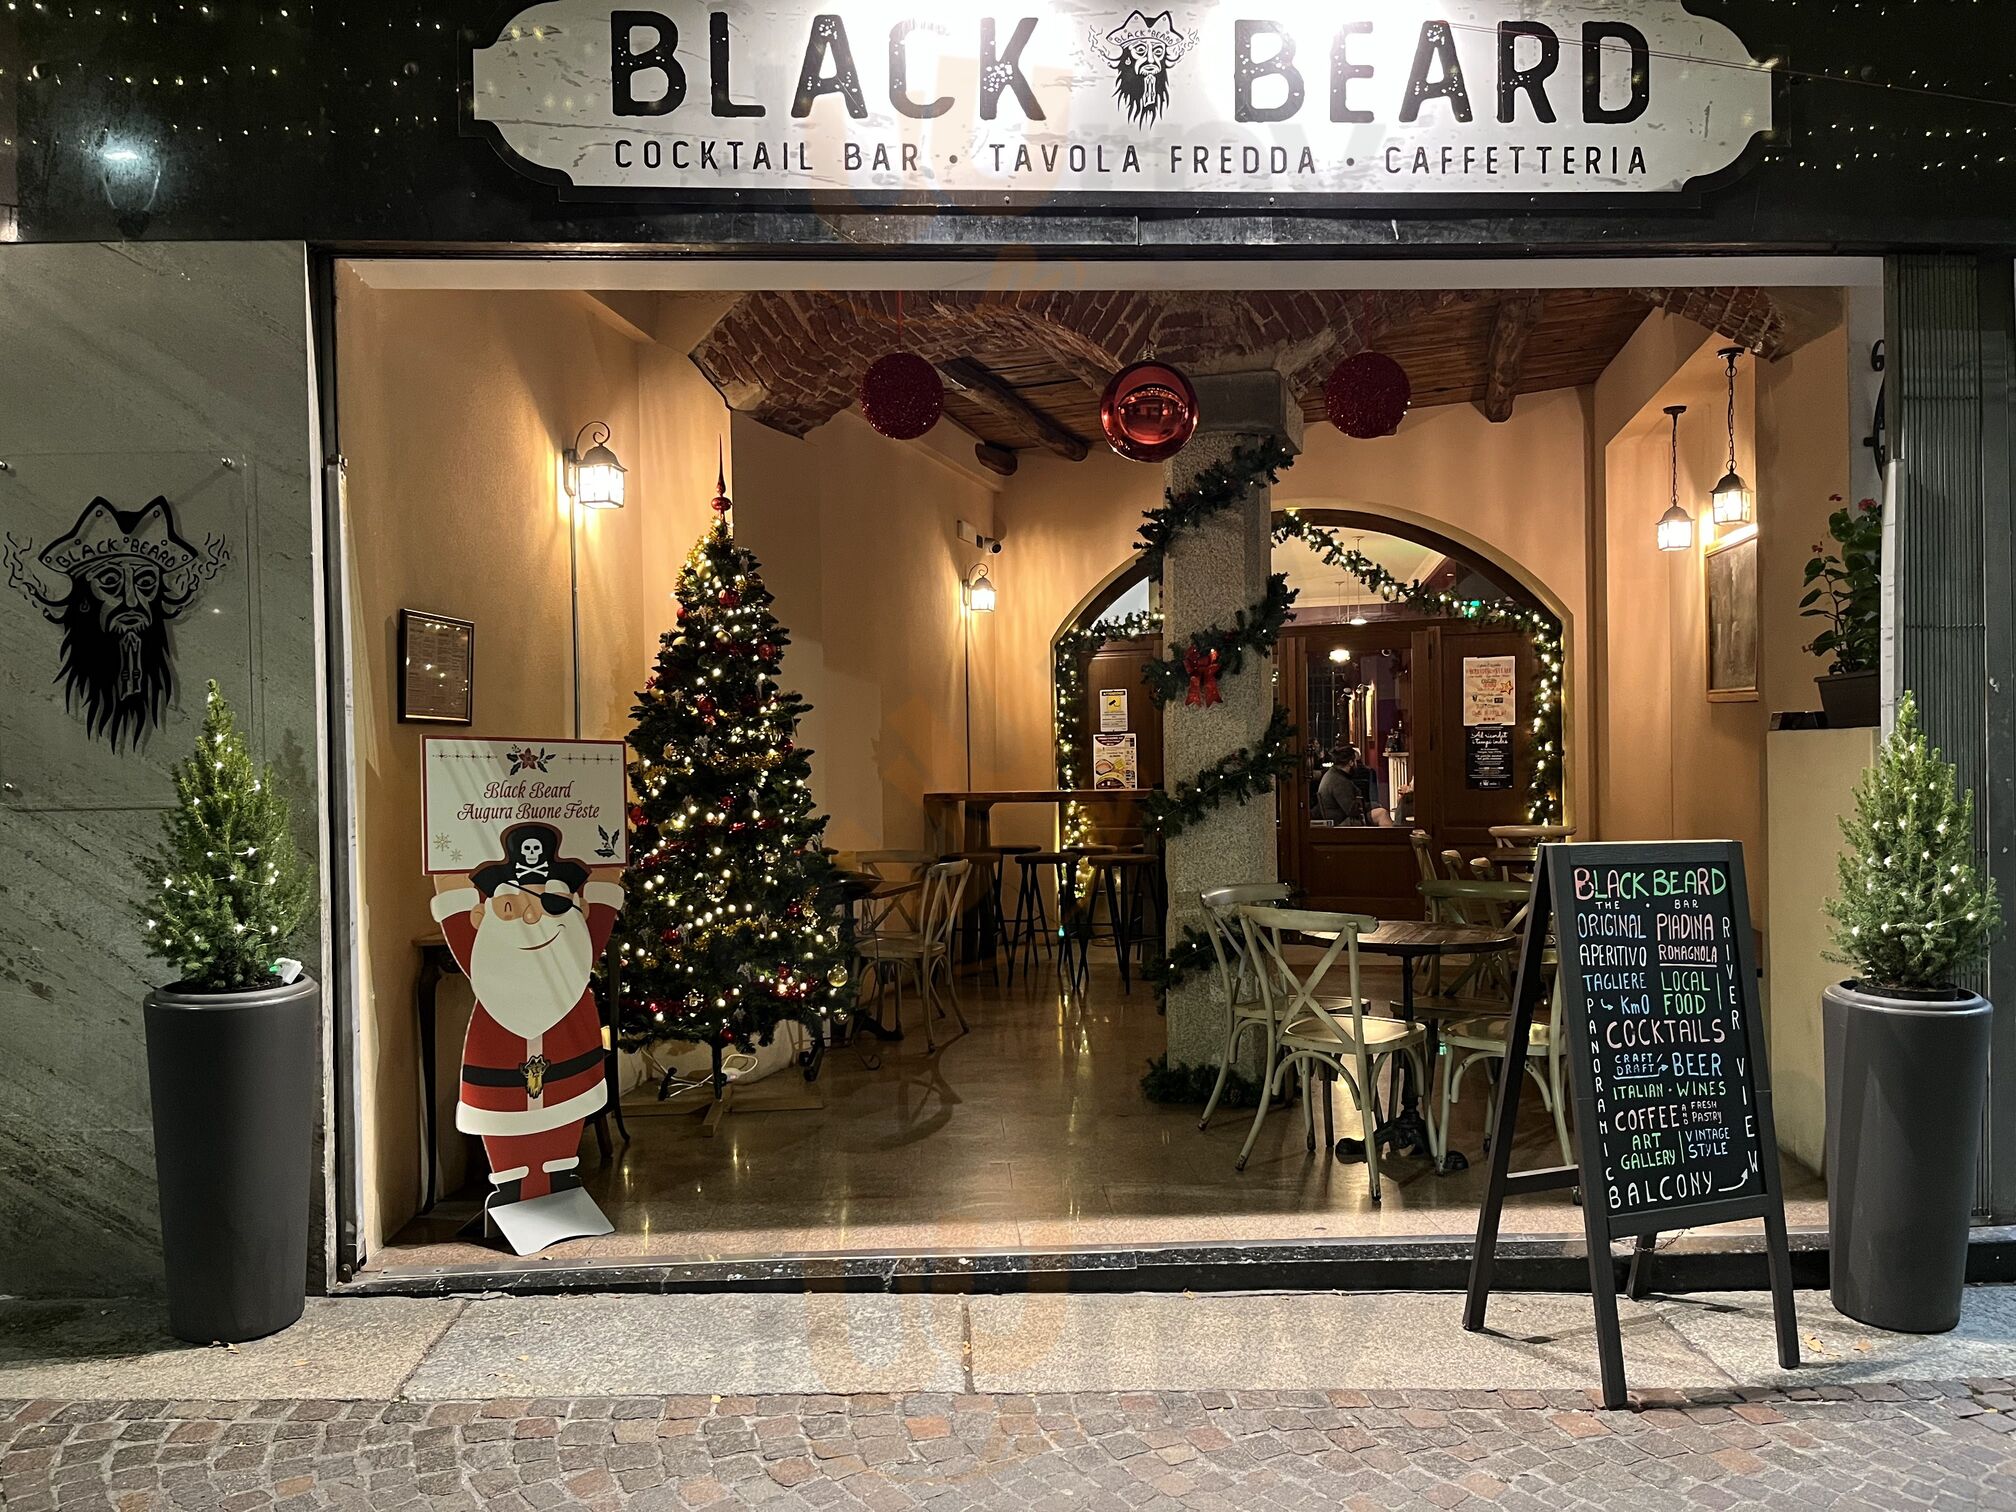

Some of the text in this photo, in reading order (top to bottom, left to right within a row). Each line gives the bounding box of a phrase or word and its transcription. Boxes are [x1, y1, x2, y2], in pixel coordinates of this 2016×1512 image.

[1114, 30, 1174, 44] BLACK BEARD
[610, 10, 1650, 125] BLACK BEARD
[614, 139, 1647, 175] COCKTAIL BAR TAVOLA FREDDA CAFFETTERIA
[56, 538, 176, 568] BLACK BEARD
[484, 780, 575, 799] Black Beard
[457, 800, 600, 823] Augura Buone Feste
[1574, 867, 1726, 900] BLACK BEARD
[1595, 899, 1699, 910] THE BAR
[1577, 913, 1714, 941] ORIGINAL PIADINA
[1579, 943, 1718, 967] APERITIVO ROMAGNOLA
[1582, 971, 1711, 992] TAGLIERE LOCAL
[1663, 993, 1706, 1016] FOOD
[1606, 1018, 1726, 1049] COCKTAILS
[1616, 1064, 1655, 1076] DRAFT
[1671, 1051, 1723, 1077] BEER
[1613, 1080, 1726, 1100] ITALIAN WINES
[1690, 1100, 1718, 1110] FRESH
[1615, 1104, 1680, 1132] COFFEE
[1632, 1132, 1662, 1151] ART
[1685, 1127, 1731, 1142] VINTAGE
[1620, 1149, 1676, 1170] GALLERY
[1688, 1141, 1729, 1159] STYLE
[1608, 1170, 1713, 1209] BALCONY
